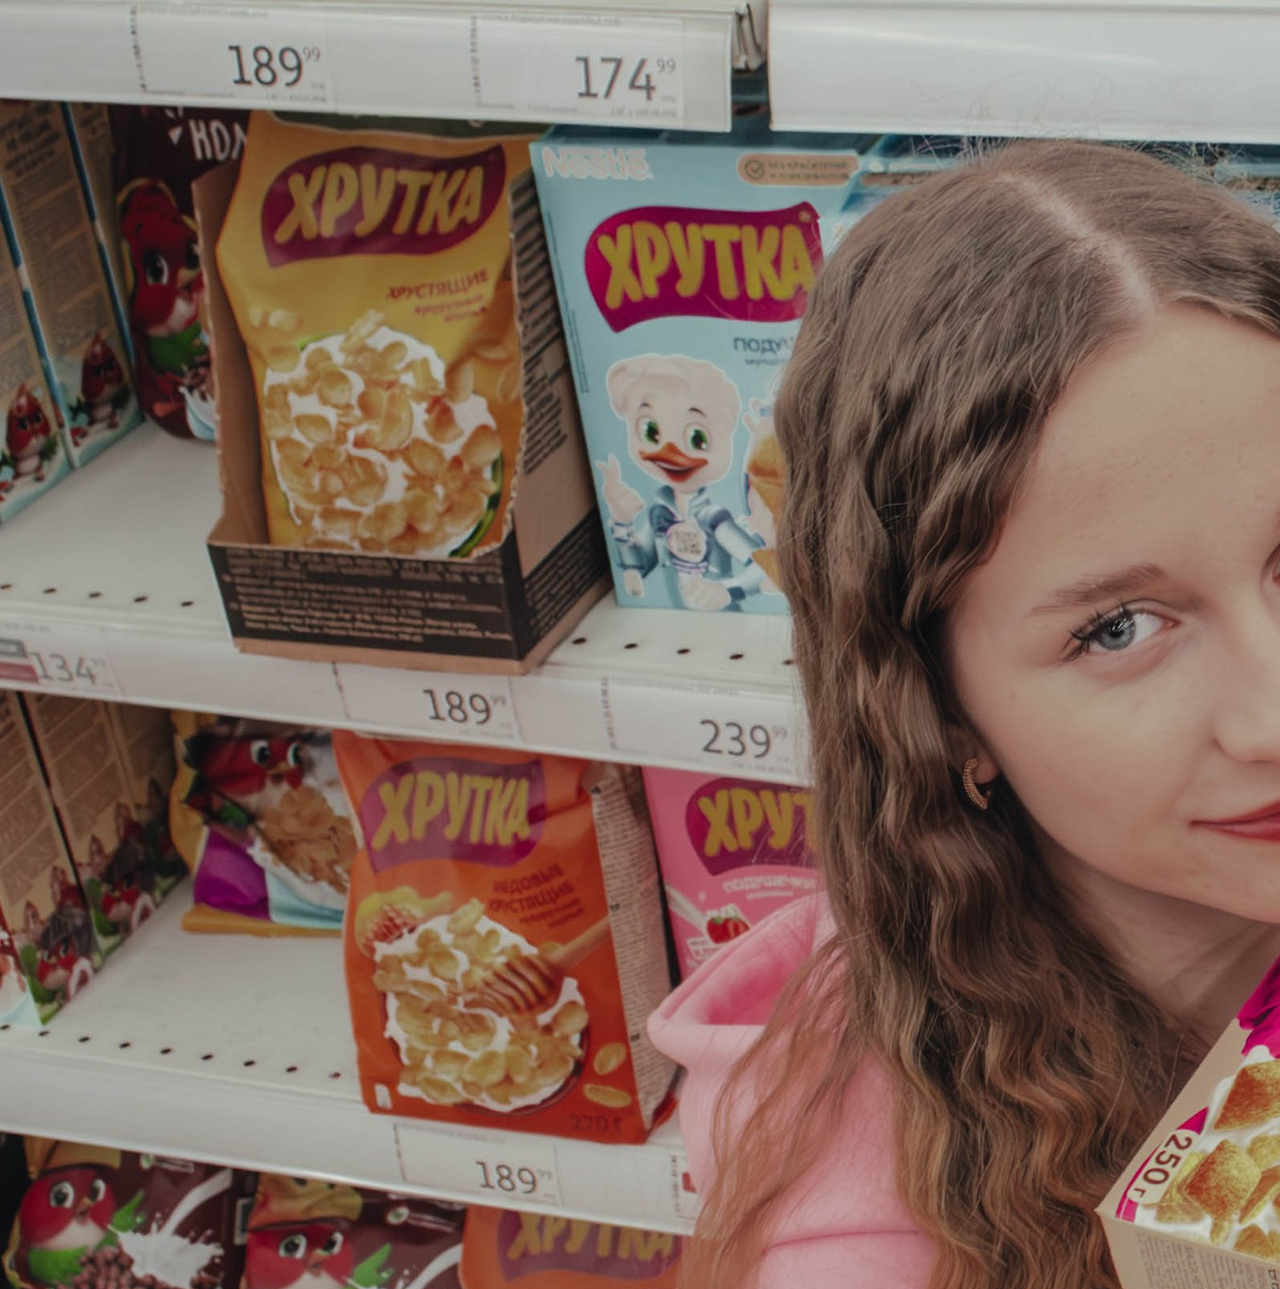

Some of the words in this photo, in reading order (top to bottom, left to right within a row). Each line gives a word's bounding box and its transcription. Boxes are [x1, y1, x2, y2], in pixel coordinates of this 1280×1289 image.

[227, 44, 303, 87] 189
[302, 46, 321, 62] 99
[574, 55, 657, 101] 174
[656, 57, 677, 74] 99
[275, 162, 484, 244] ХРУТКА
[388, 268, 489, 302] ХРУСТЯЩИЕ
[598, 221, 815, 310] ХРУТКА
[423, 689, 492, 725] 189
[699, 719, 772, 758] 239
[371, 770, 531, 852] ХРУТКА
[475, 1159, 538, 1195] 189
[1141, 1132, 1193, 1187] 250
